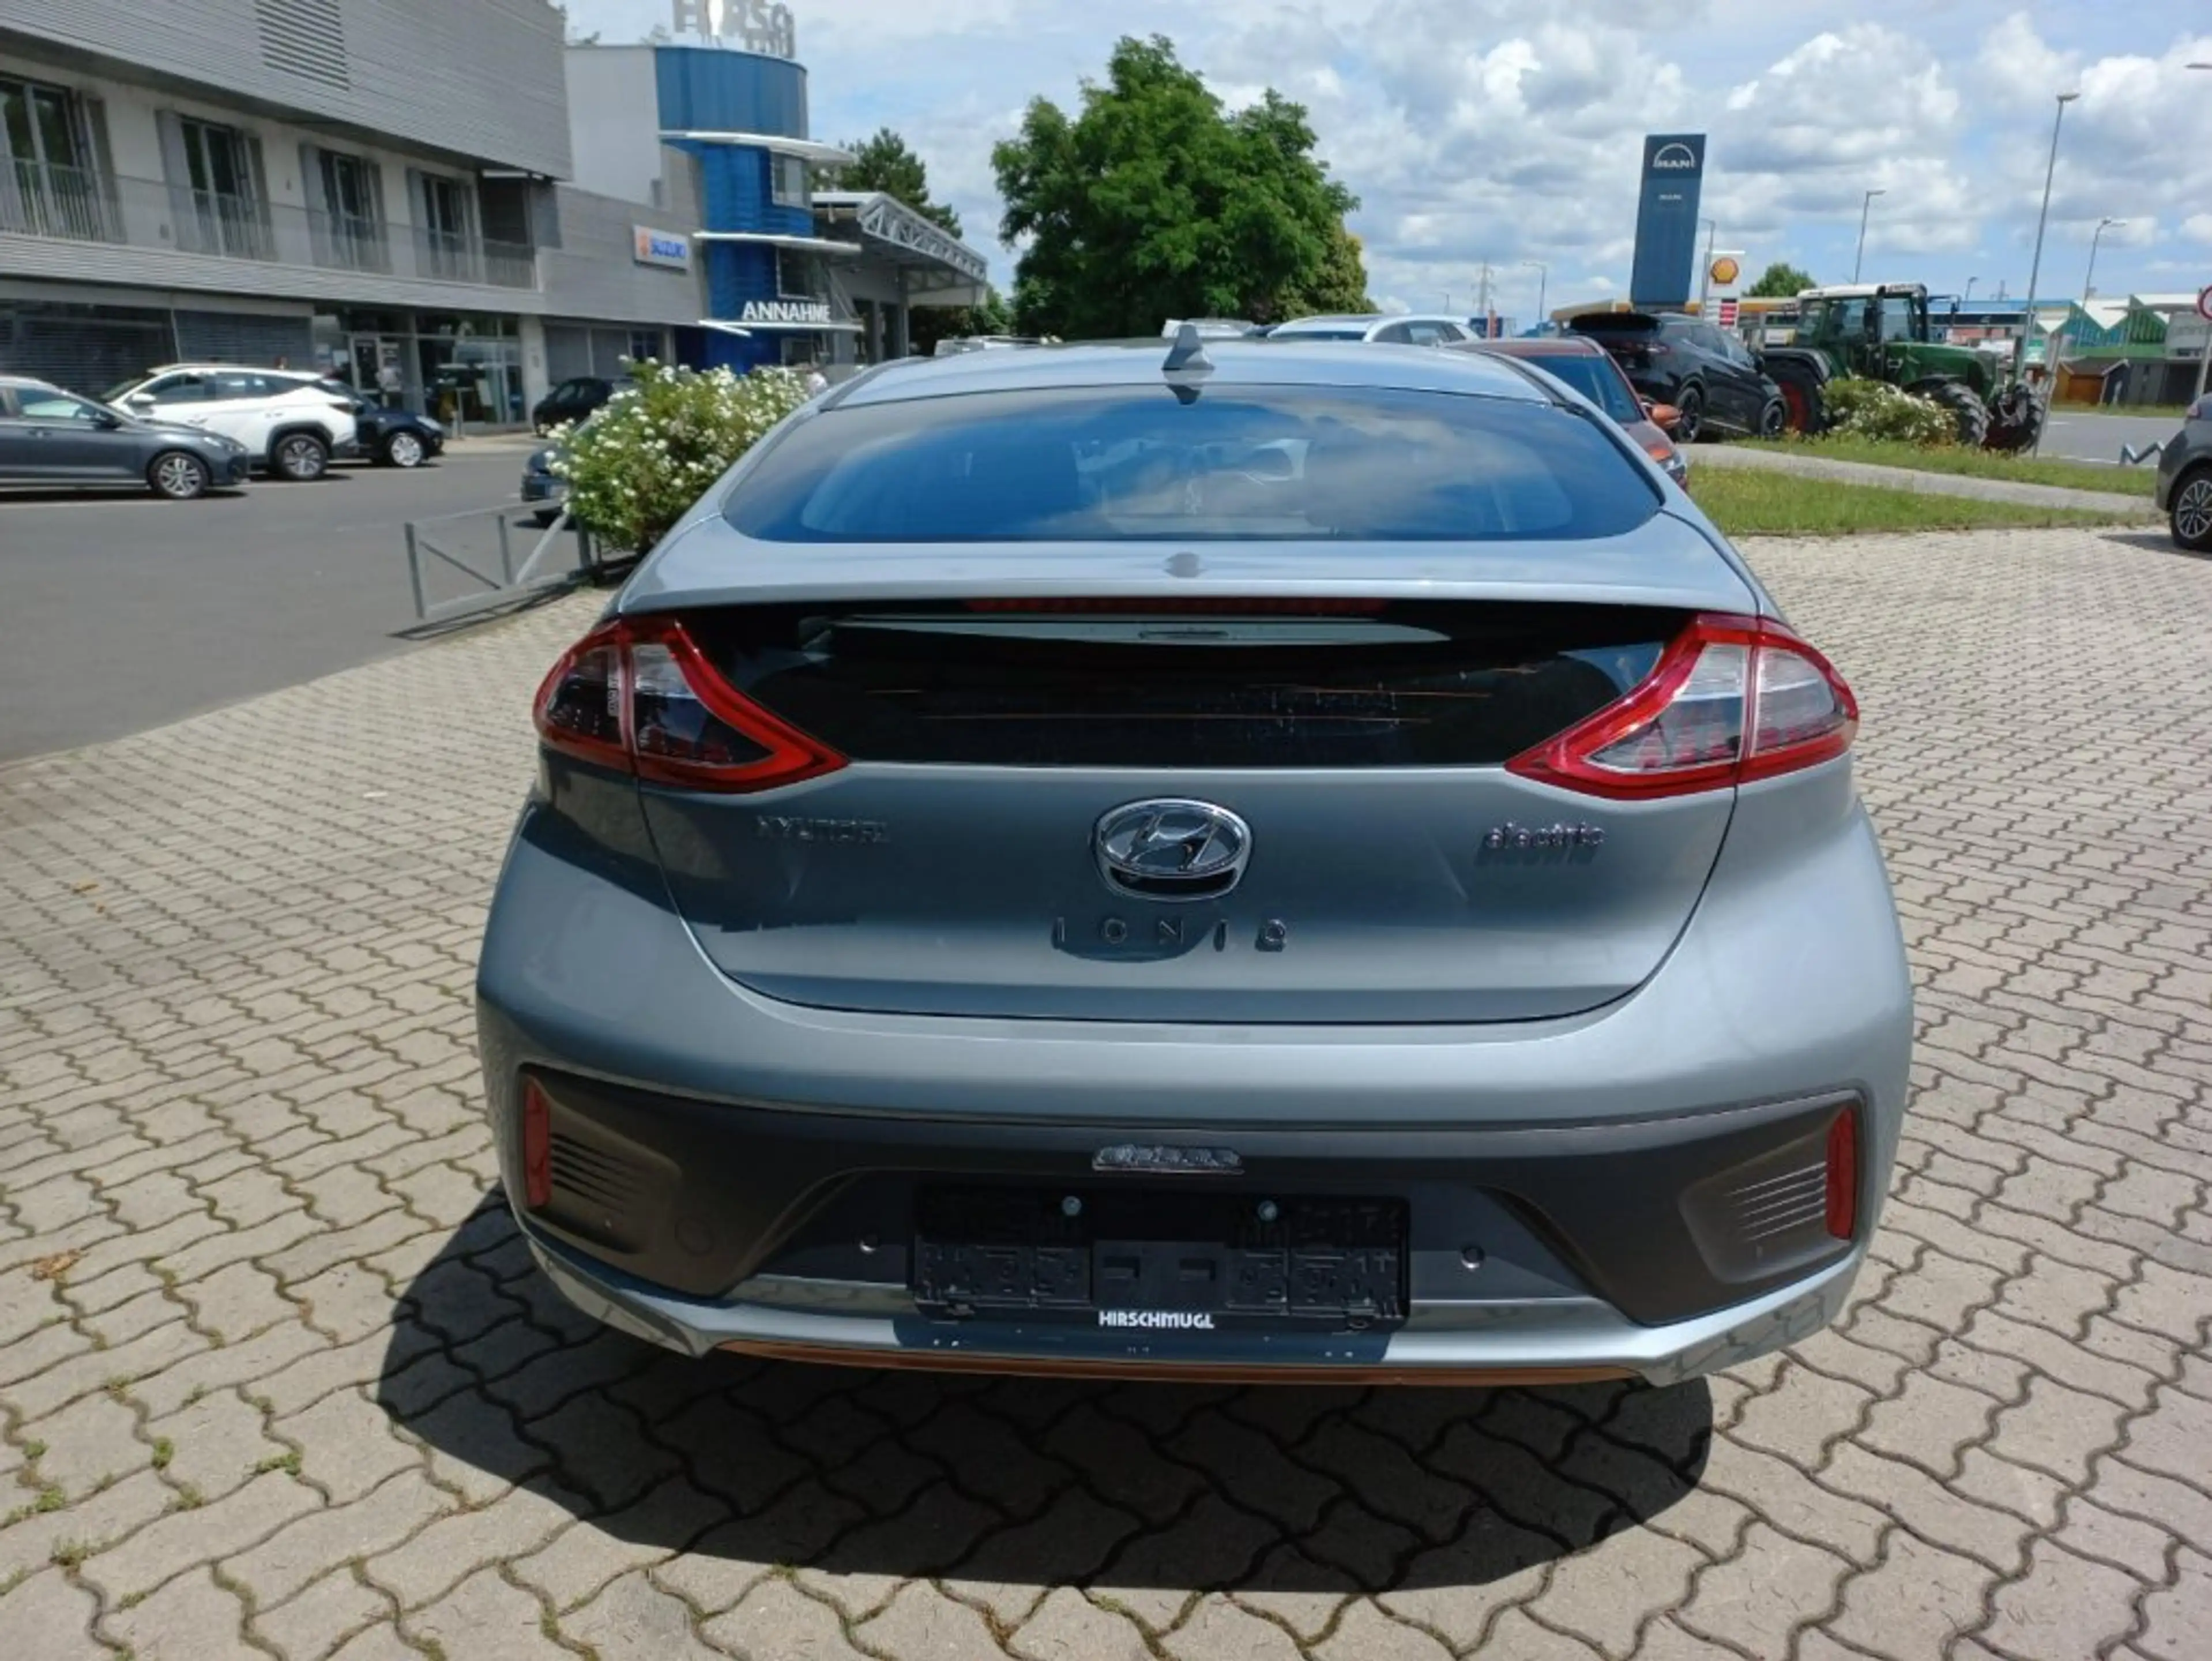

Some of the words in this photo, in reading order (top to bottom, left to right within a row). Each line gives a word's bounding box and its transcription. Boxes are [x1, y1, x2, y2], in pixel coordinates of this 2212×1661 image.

[1657, 159, 1691, 168] MAN
[650, 238, 686, 259] SUZUKI
[742, 300, 831, 323] ANNAHME
[1485, 821, 1607, 848] electric
[1098, 1310, 1215, 1329] HIRSCHMUGL
